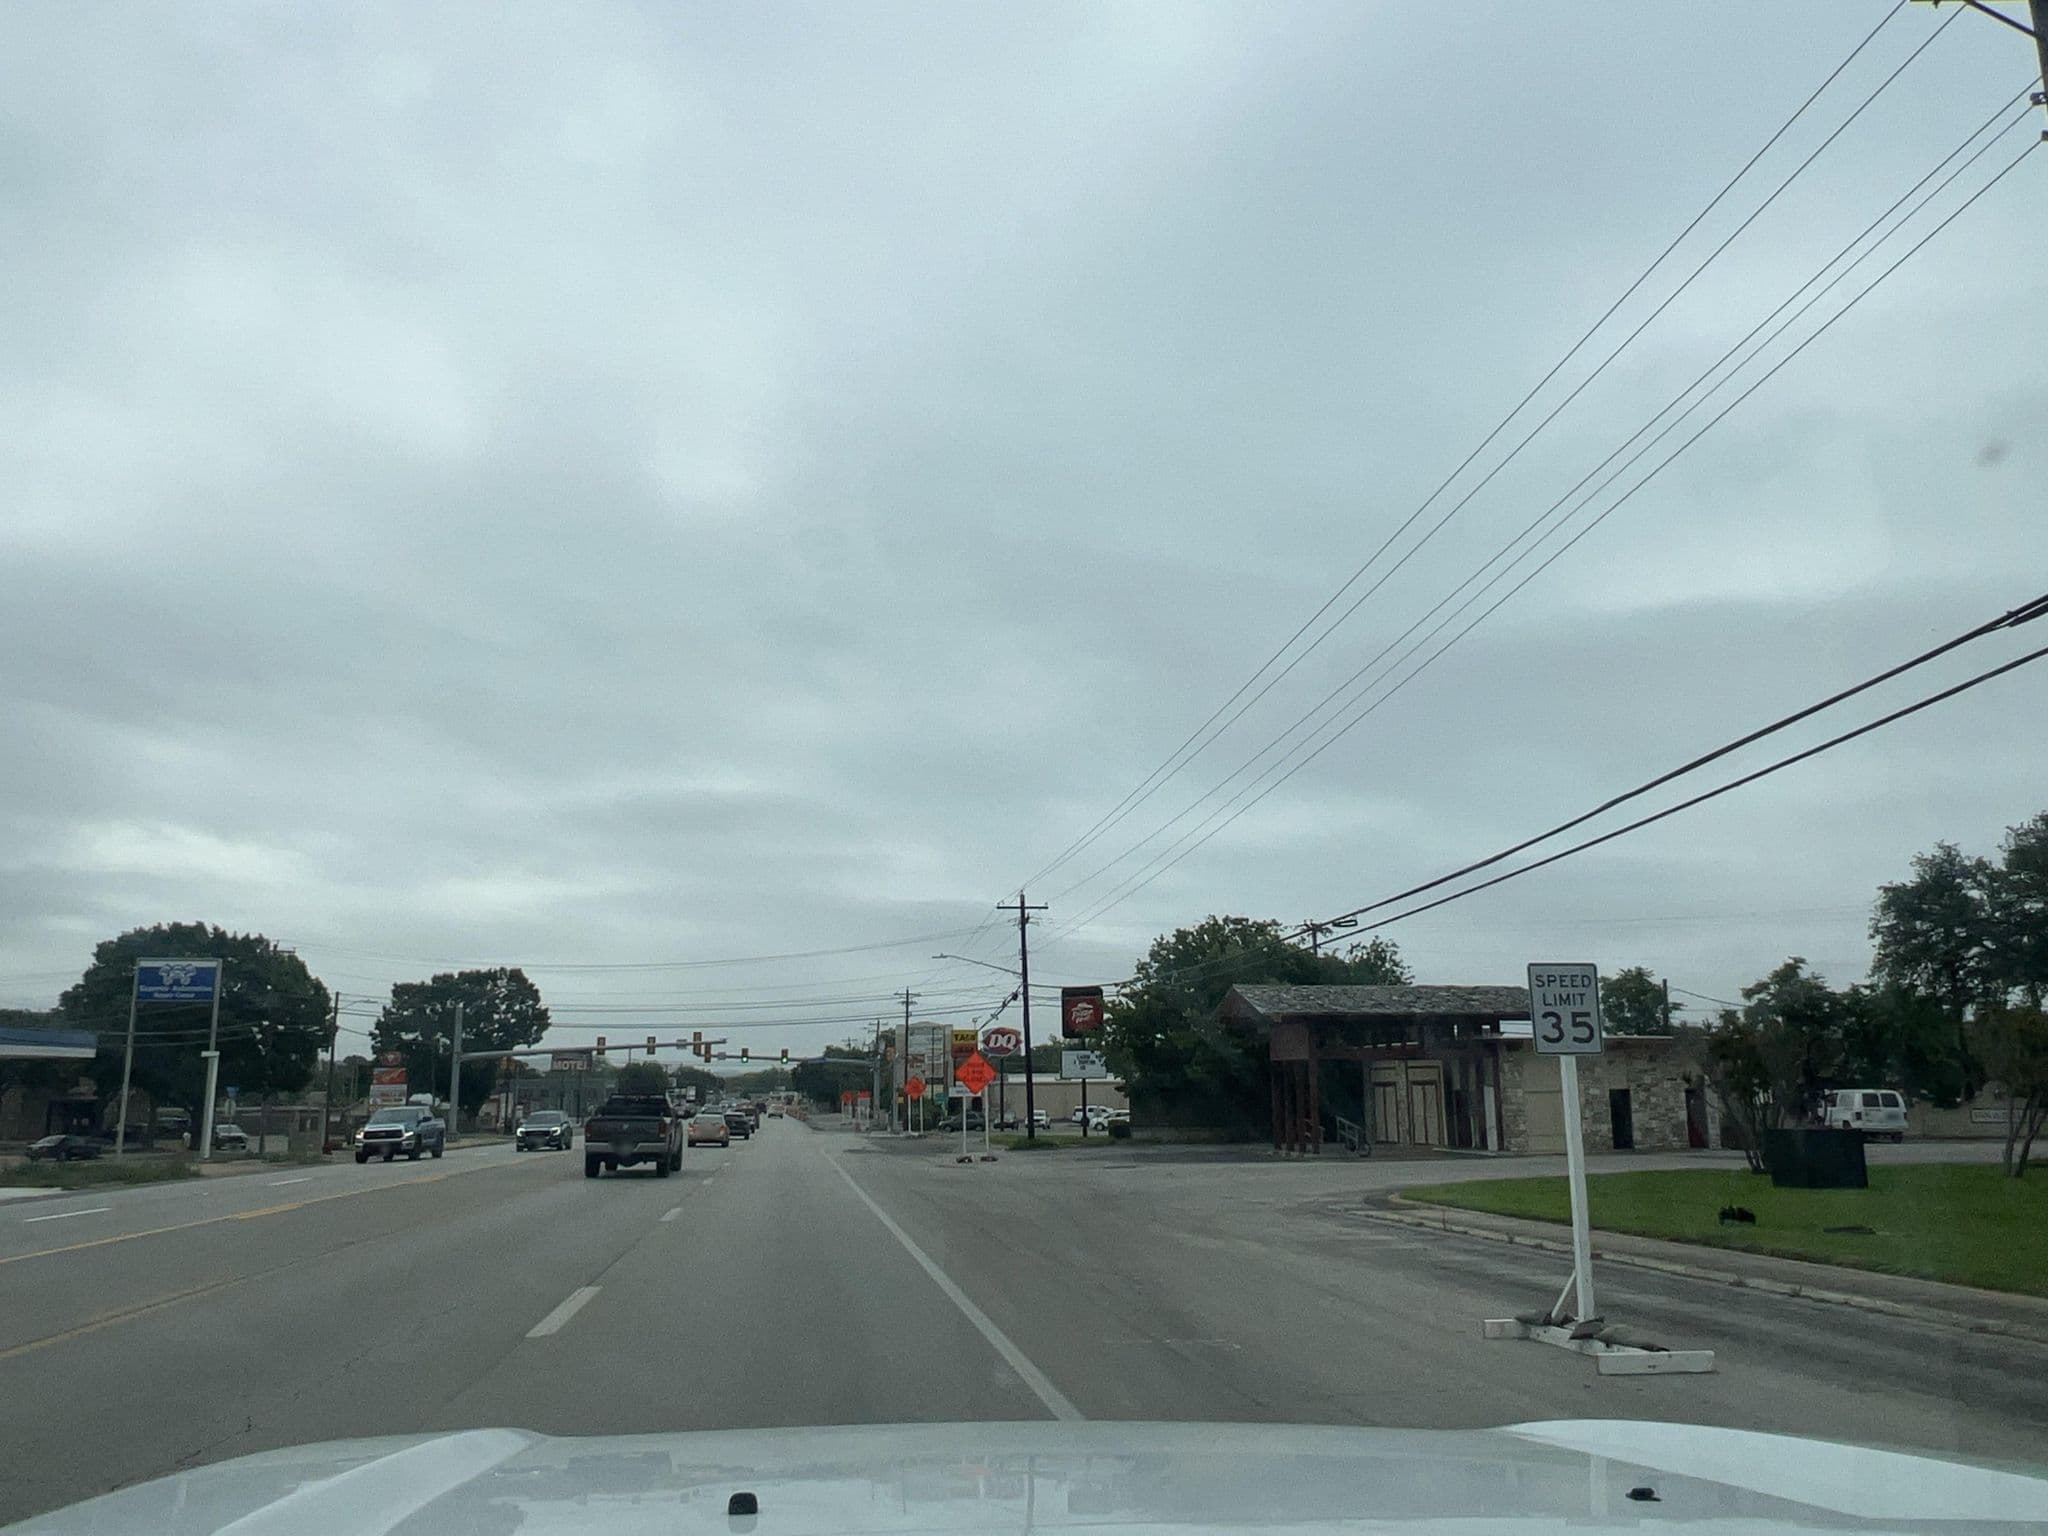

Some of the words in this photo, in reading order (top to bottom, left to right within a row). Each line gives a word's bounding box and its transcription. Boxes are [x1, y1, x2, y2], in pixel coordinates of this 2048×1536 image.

[1535, 974, 1591, 988] SPEED
[1542, 993, 1586, 1006] LIMIT
[1541, 1011, 1594, 1044] 35
[989, 1033, 1017, 1050] DQ
[552, 1060, 588, 1071] MOTEL
